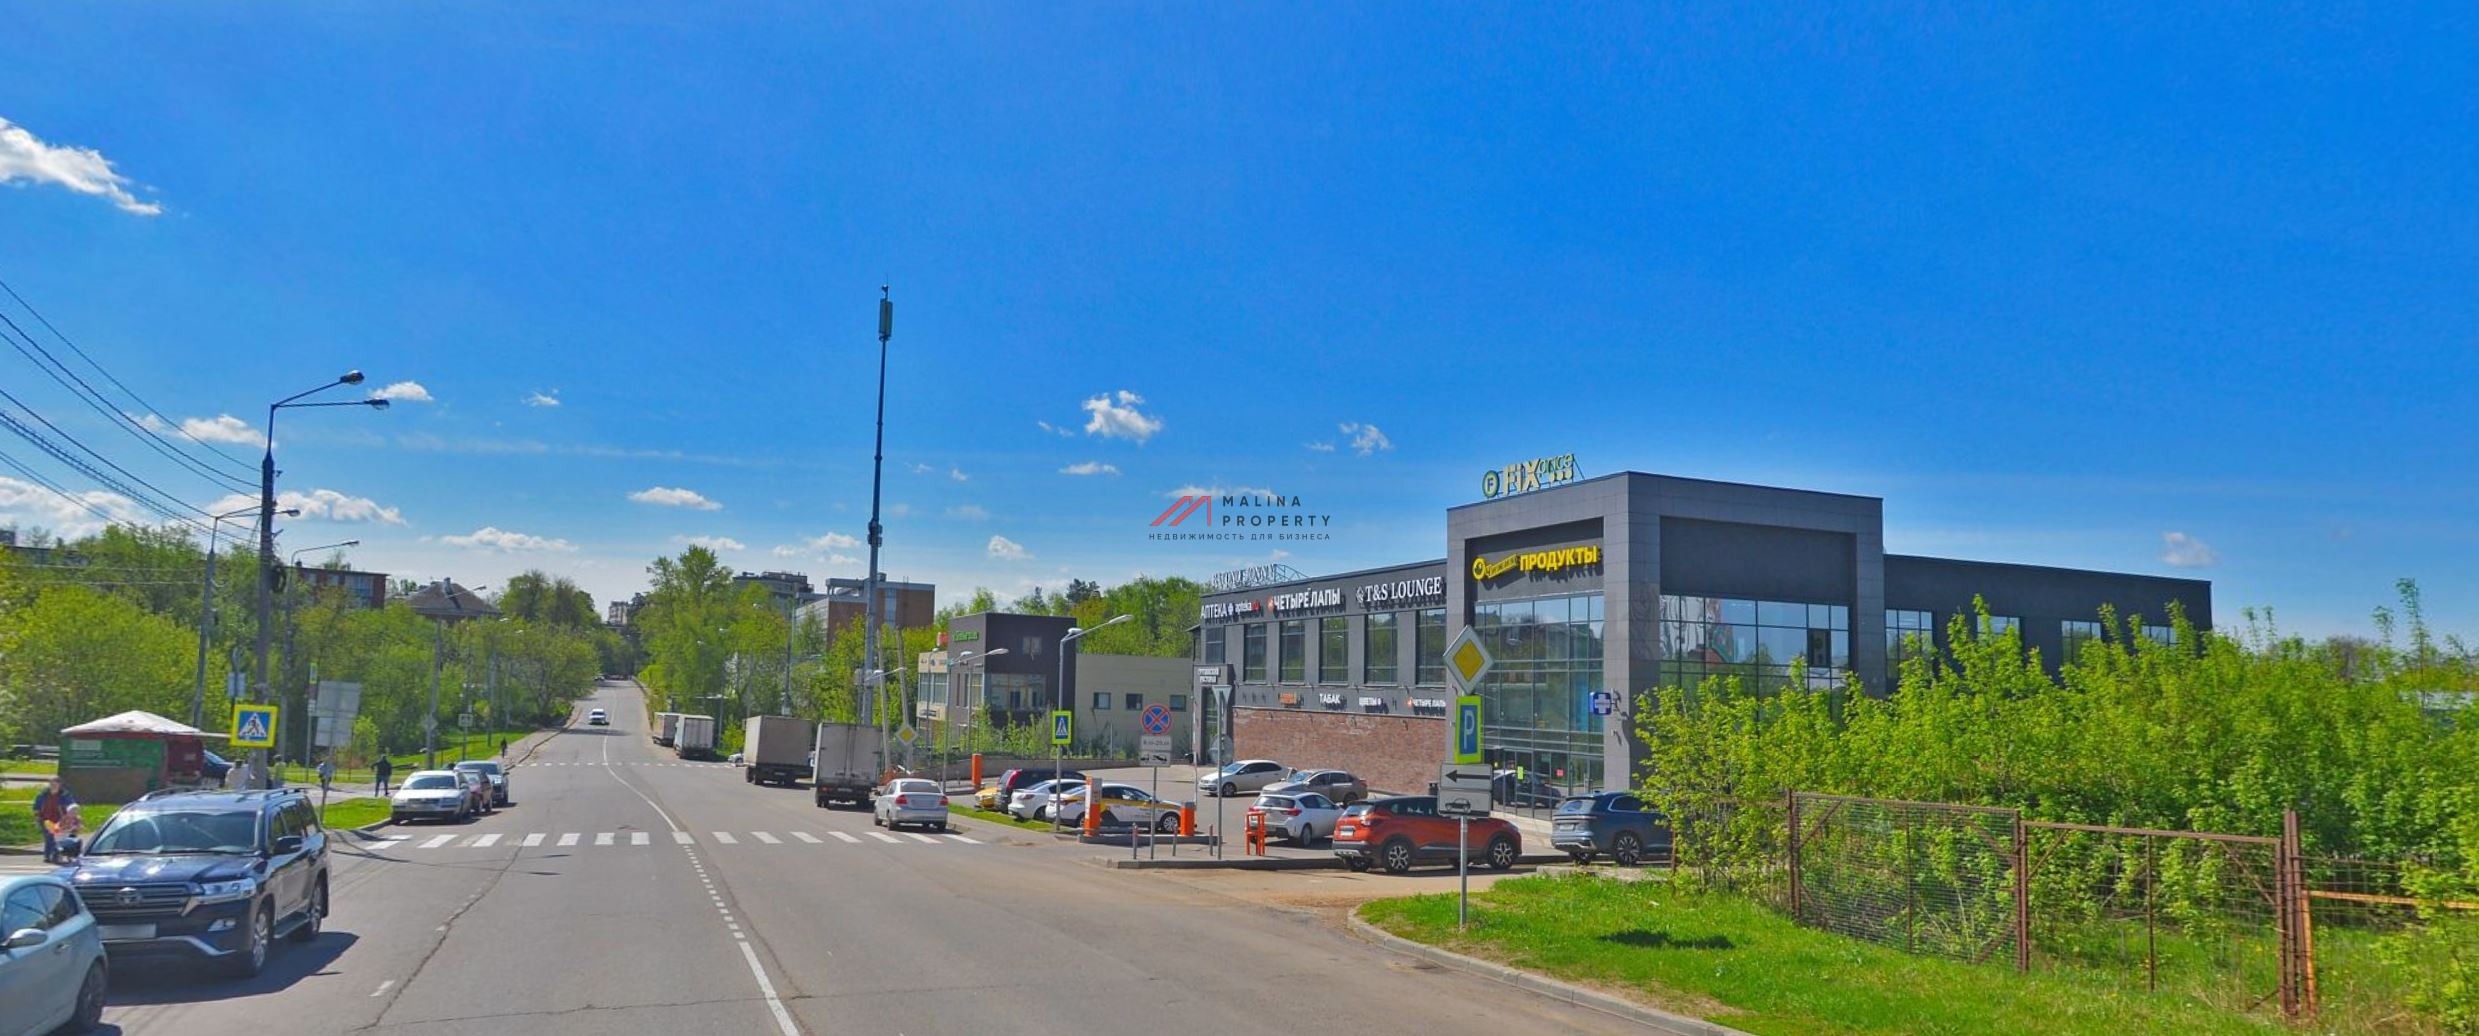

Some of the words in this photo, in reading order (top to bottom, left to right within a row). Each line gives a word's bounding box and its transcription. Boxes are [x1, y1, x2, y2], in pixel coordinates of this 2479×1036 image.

[1519, 544, 1598, 572] ПРОДУКТЫ
[1273, 592, 1309, 611] ЧЕТЫРЕ
[1309, 588, 1341, 607] ЛАПЫ
[1365, 583, 1389, 603] T&S
[1391, 576, 1442, 600] LOUNGE
[1201, 602, 1228, 619] АПТЕКА
[1319, 693, 1341, 704] ТАБАК
